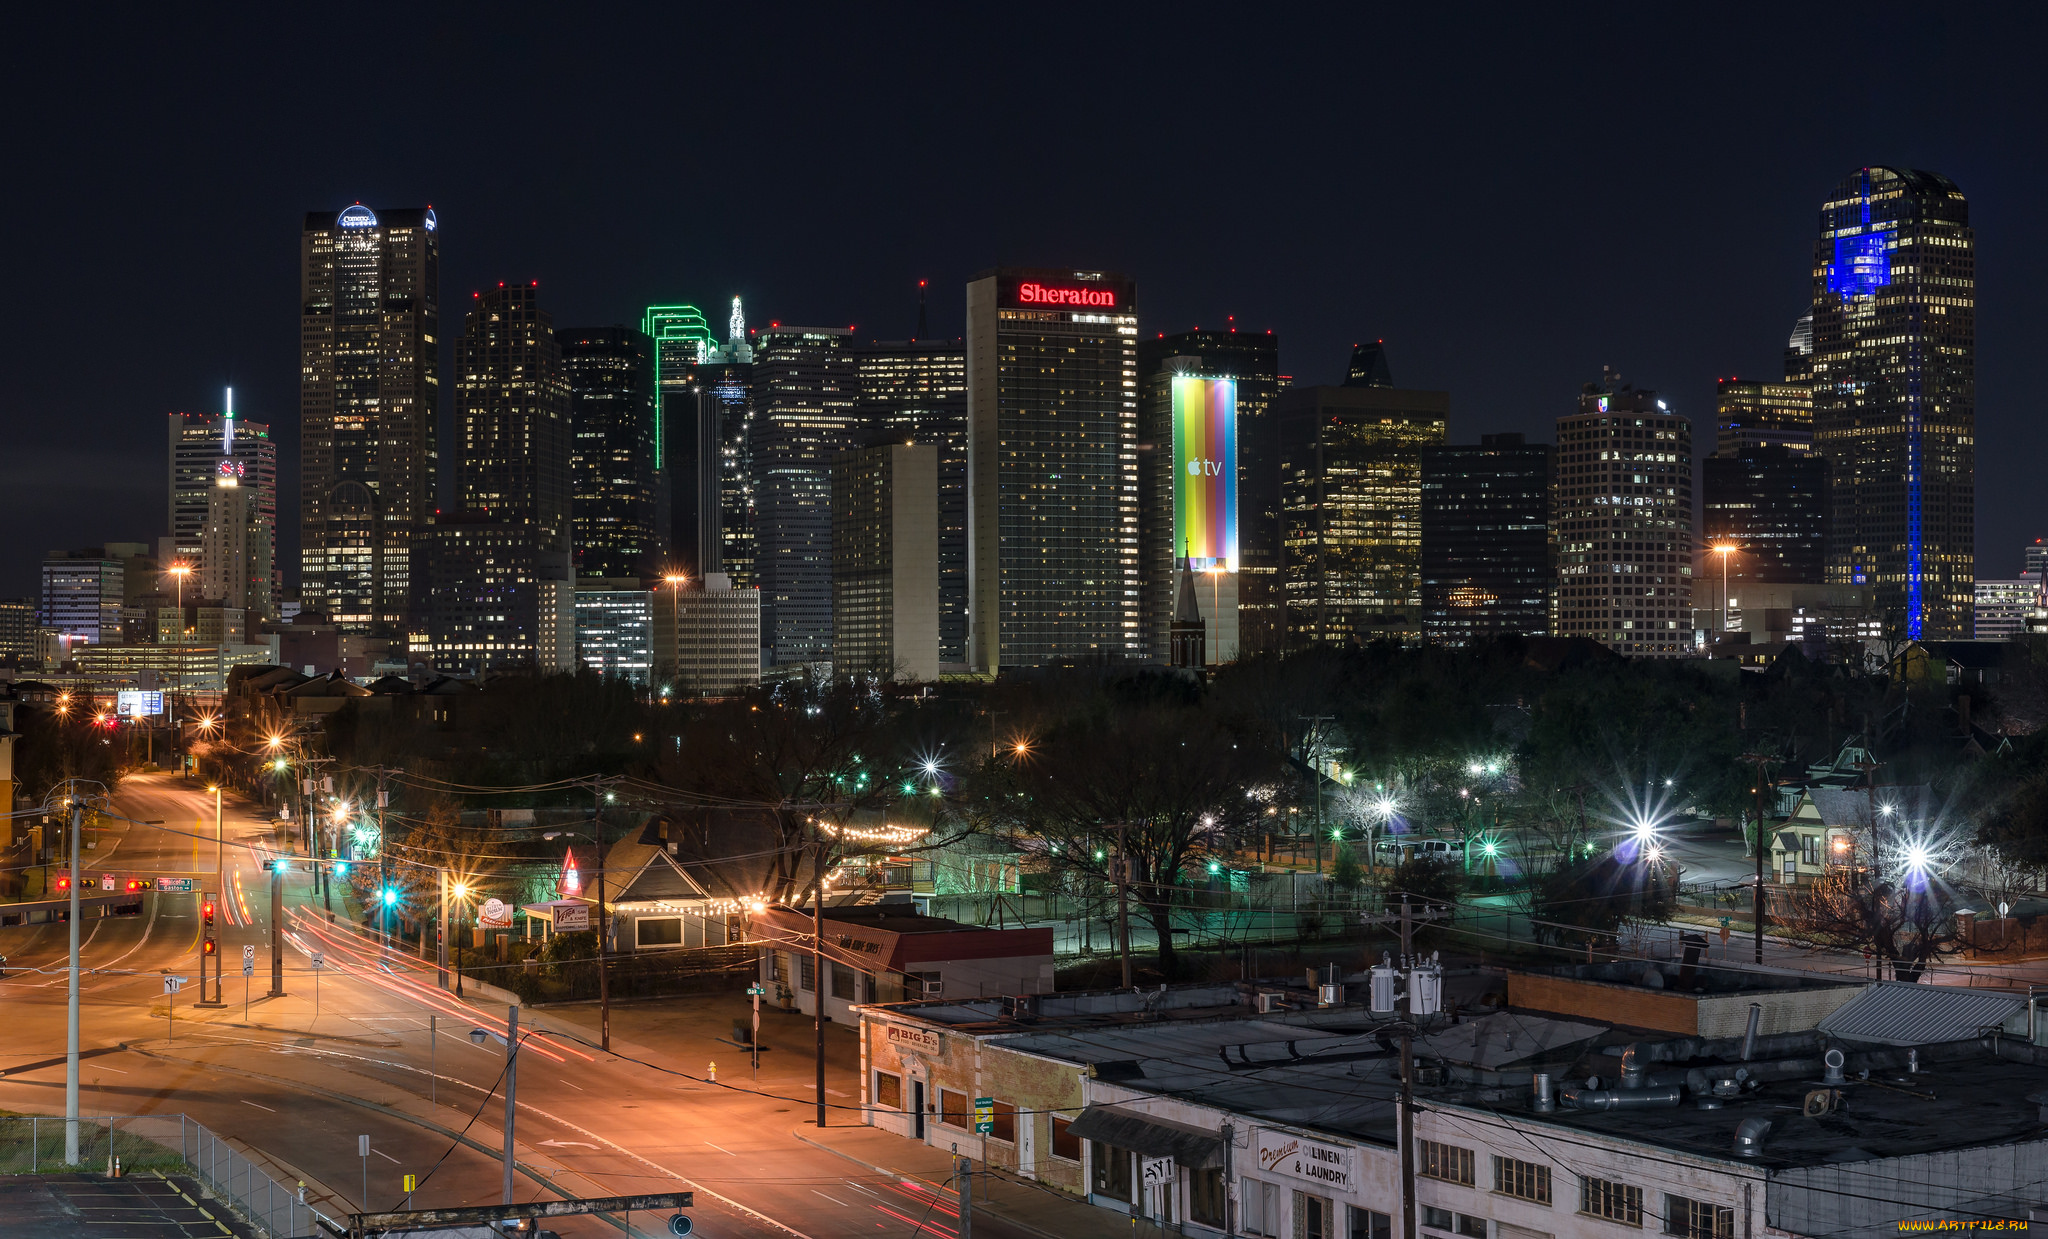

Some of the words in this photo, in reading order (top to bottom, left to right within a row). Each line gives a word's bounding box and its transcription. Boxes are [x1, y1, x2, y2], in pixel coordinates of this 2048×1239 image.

[1020, 283, 1115, 306] Sheraton
[1203, 458, 1222, 476] tv
[901, 1030, 921, 1042] BIG
[923, 1035, 938, 1046] E's
[1261, 1140, 1299, 1166] Premium
[1312, 1147, 1340, 1165] LINEN
[1295, 1160, 1301, 1173] &
[1306, 1164, 1347, 1185] LAUNDRY
